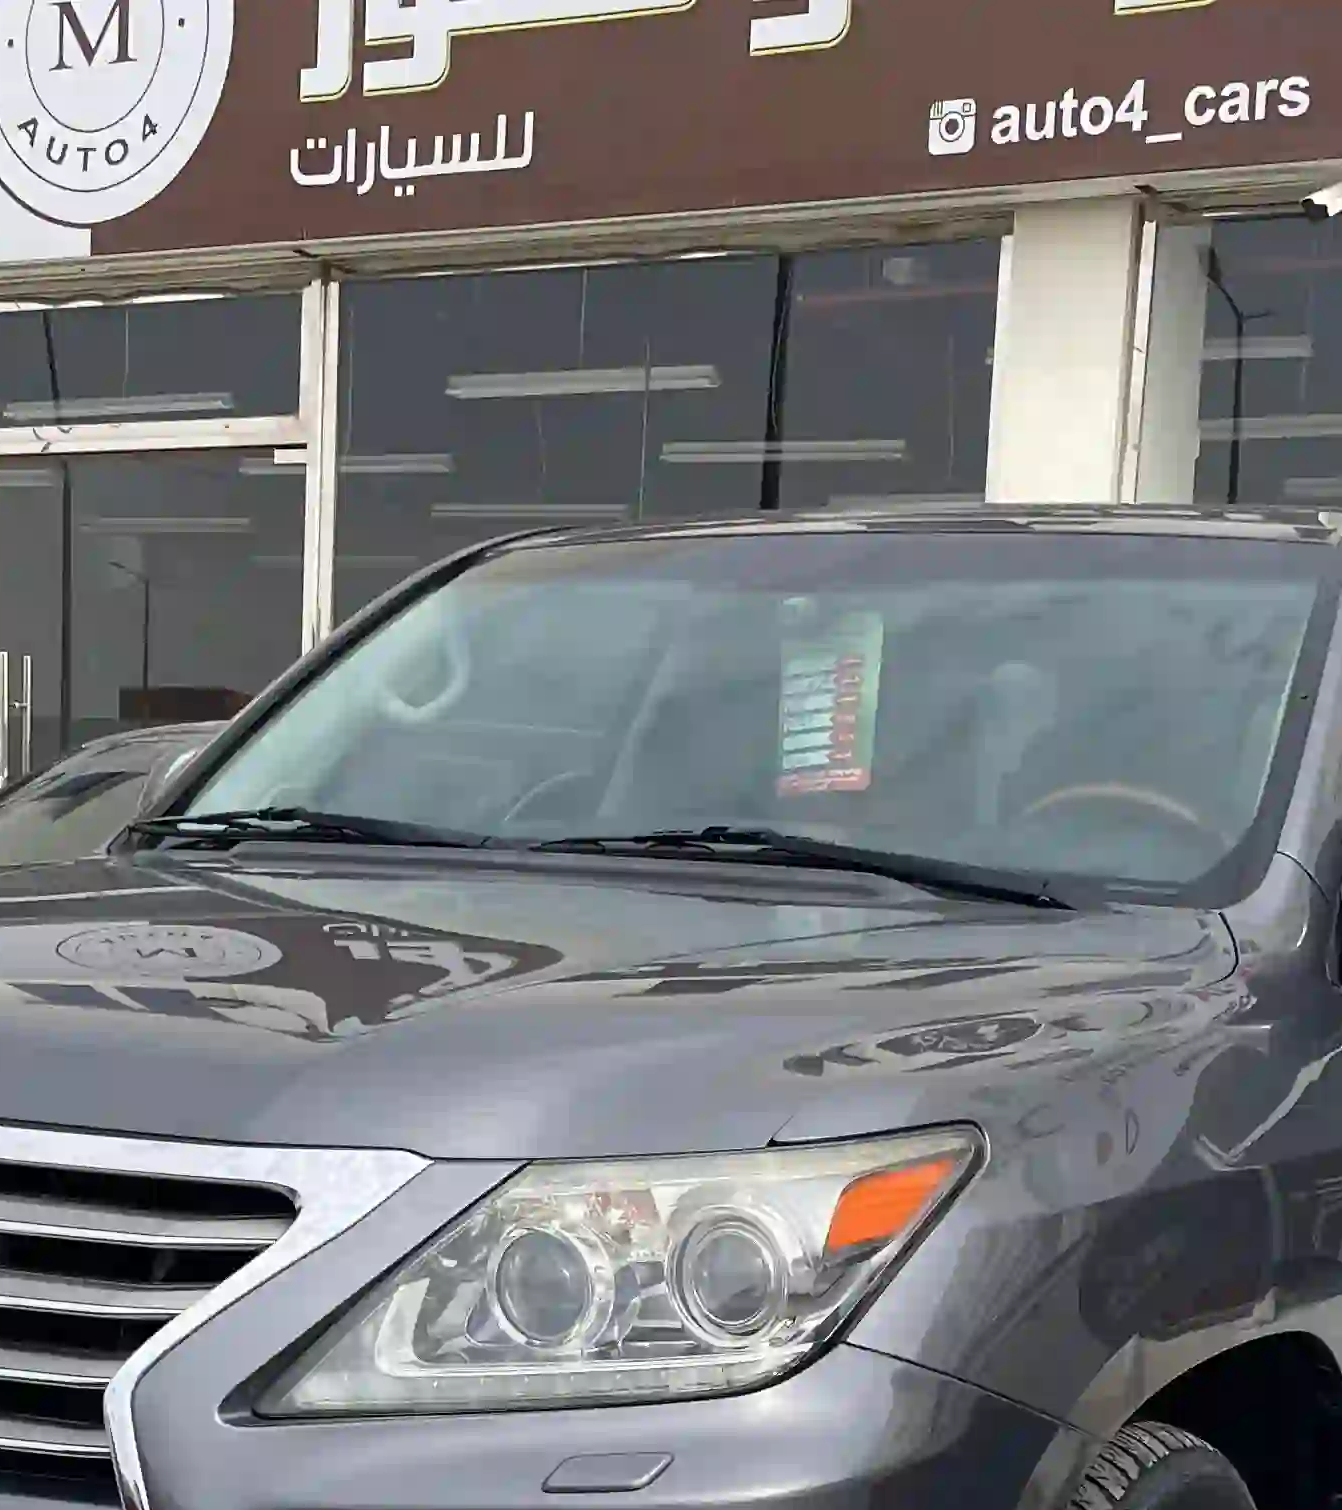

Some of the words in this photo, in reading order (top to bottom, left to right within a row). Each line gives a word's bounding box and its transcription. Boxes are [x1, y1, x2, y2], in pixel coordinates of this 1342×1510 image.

[48, 0, 138, 71] M
[17, 116, 129, 172] AUTO
[142, 113, 158, 142] 4
[990, 75, 1310, 144] auto4_cars
[289, 111, 535, 196] للسيارات
